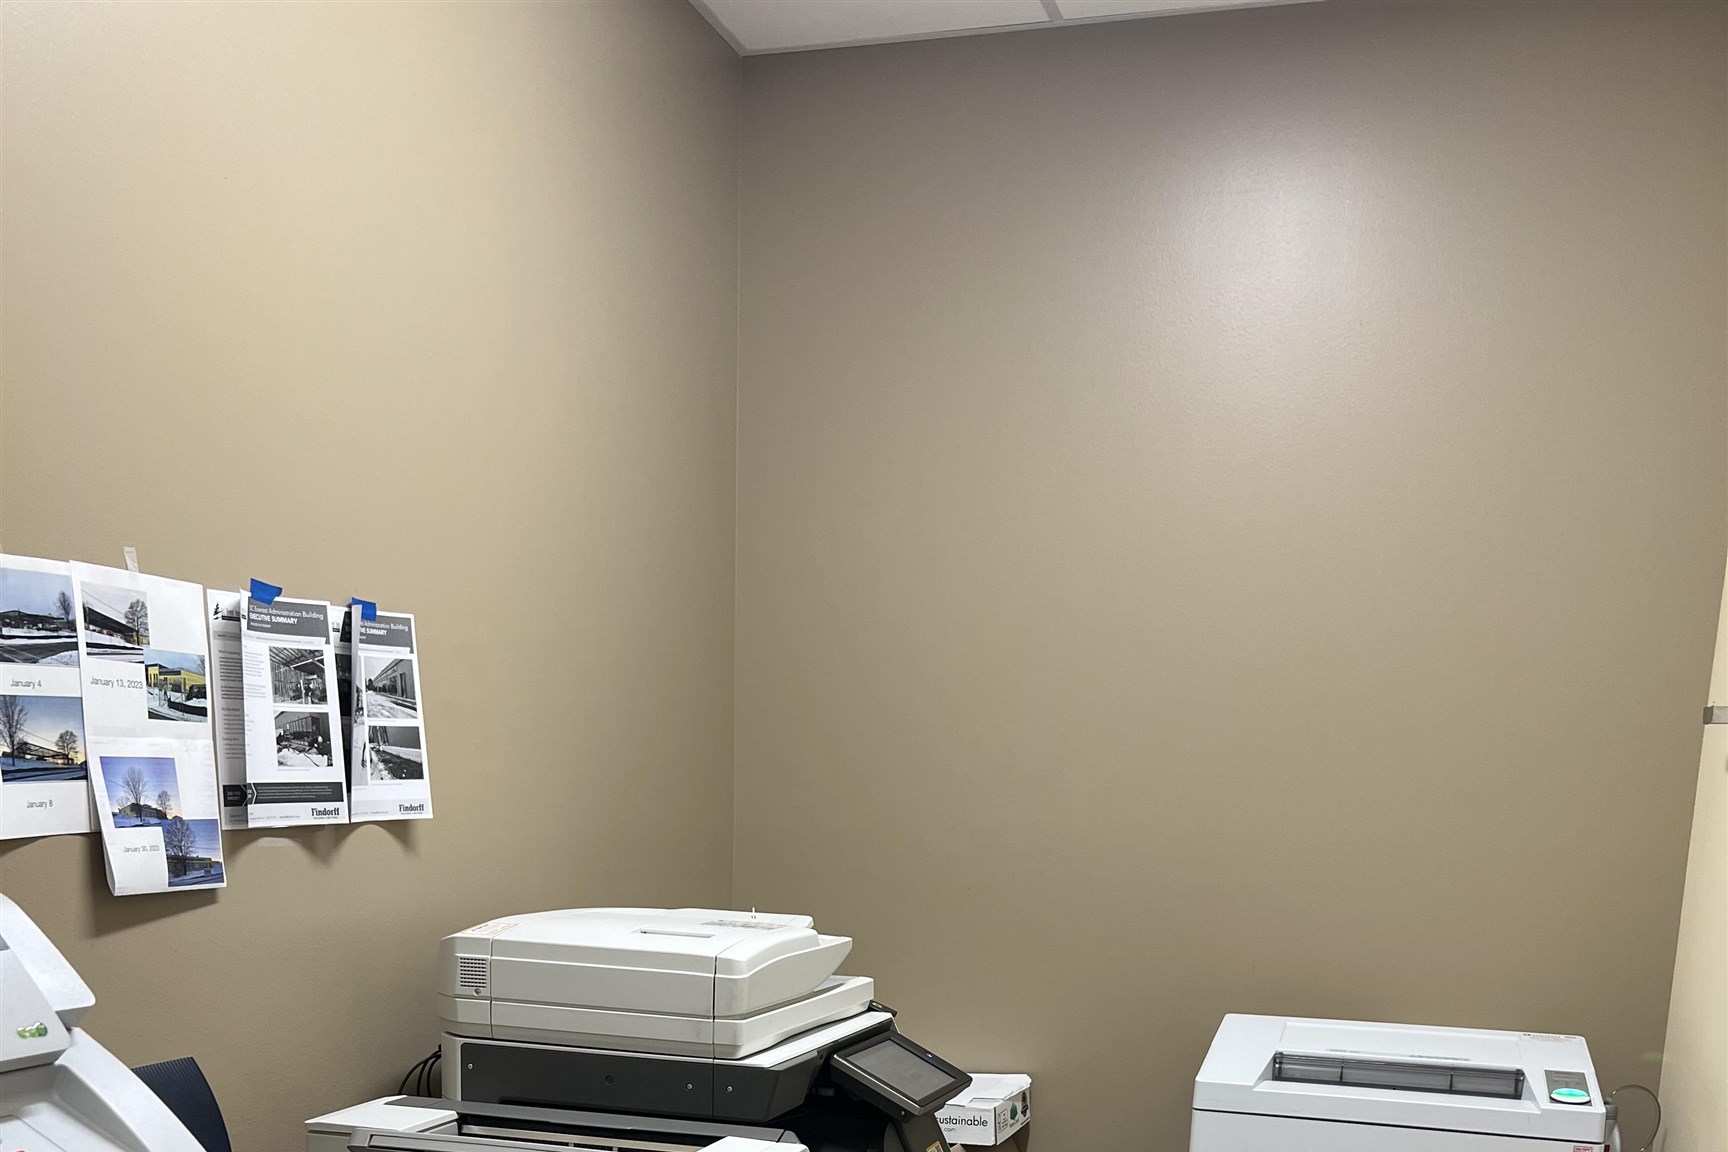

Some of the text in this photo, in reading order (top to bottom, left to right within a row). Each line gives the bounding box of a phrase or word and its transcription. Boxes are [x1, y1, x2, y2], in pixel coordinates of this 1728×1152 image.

[249, 613, 271, 622] EXECUTIVE
[271, 616, 298, 624] SUMMARY
[269, 608, 302, 617] Administration
[302, 611, 323, 620] Building
[366, 627, 387, 636] SUMMARY
[390, 623, 408, 632] Building
[10, 679, 36, 689] January
[90, 676, 143, 689] January 13, 2023
[26, 799, 53, 809] January 8
[398, 804, 425, 813] Findorff
[311, 807, 340, 817] Findorff
[123, 846, 141, 854] January
